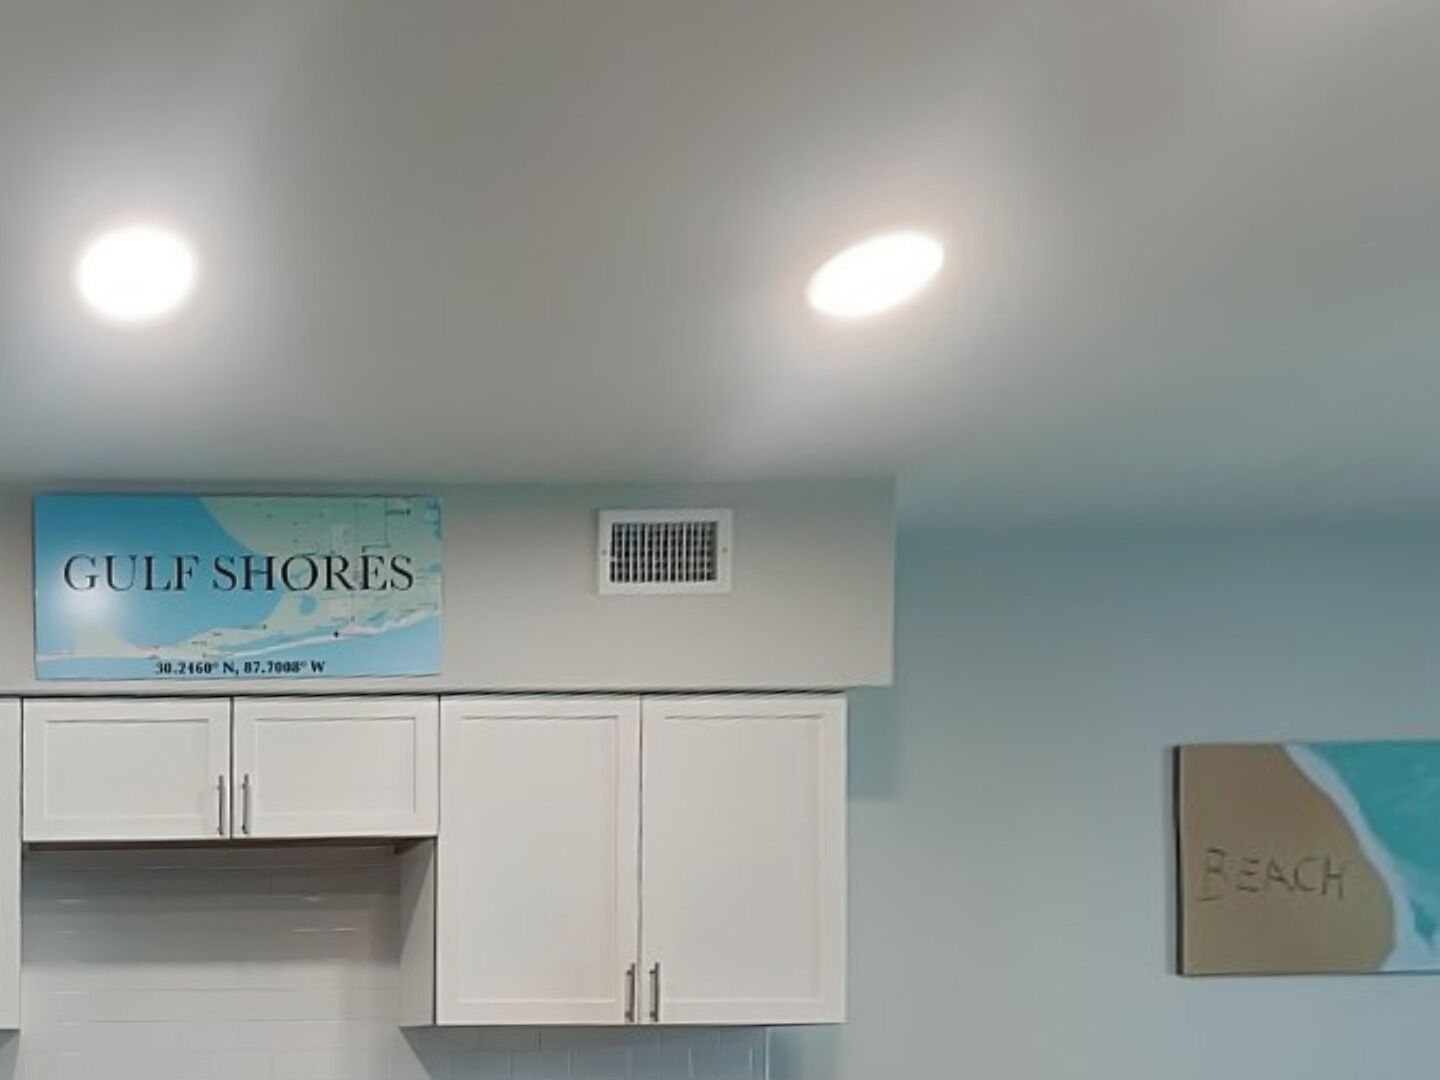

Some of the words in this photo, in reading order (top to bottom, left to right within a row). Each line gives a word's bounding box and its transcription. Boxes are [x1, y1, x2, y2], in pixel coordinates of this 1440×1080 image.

[63, 553, 199, 592] GULF
[213, 553, 415, 592] SHORES
[223, 660, 240, 676] N,
[310, 660, 326, 674] W
[1197, 847, 1344, 902] BEACH
